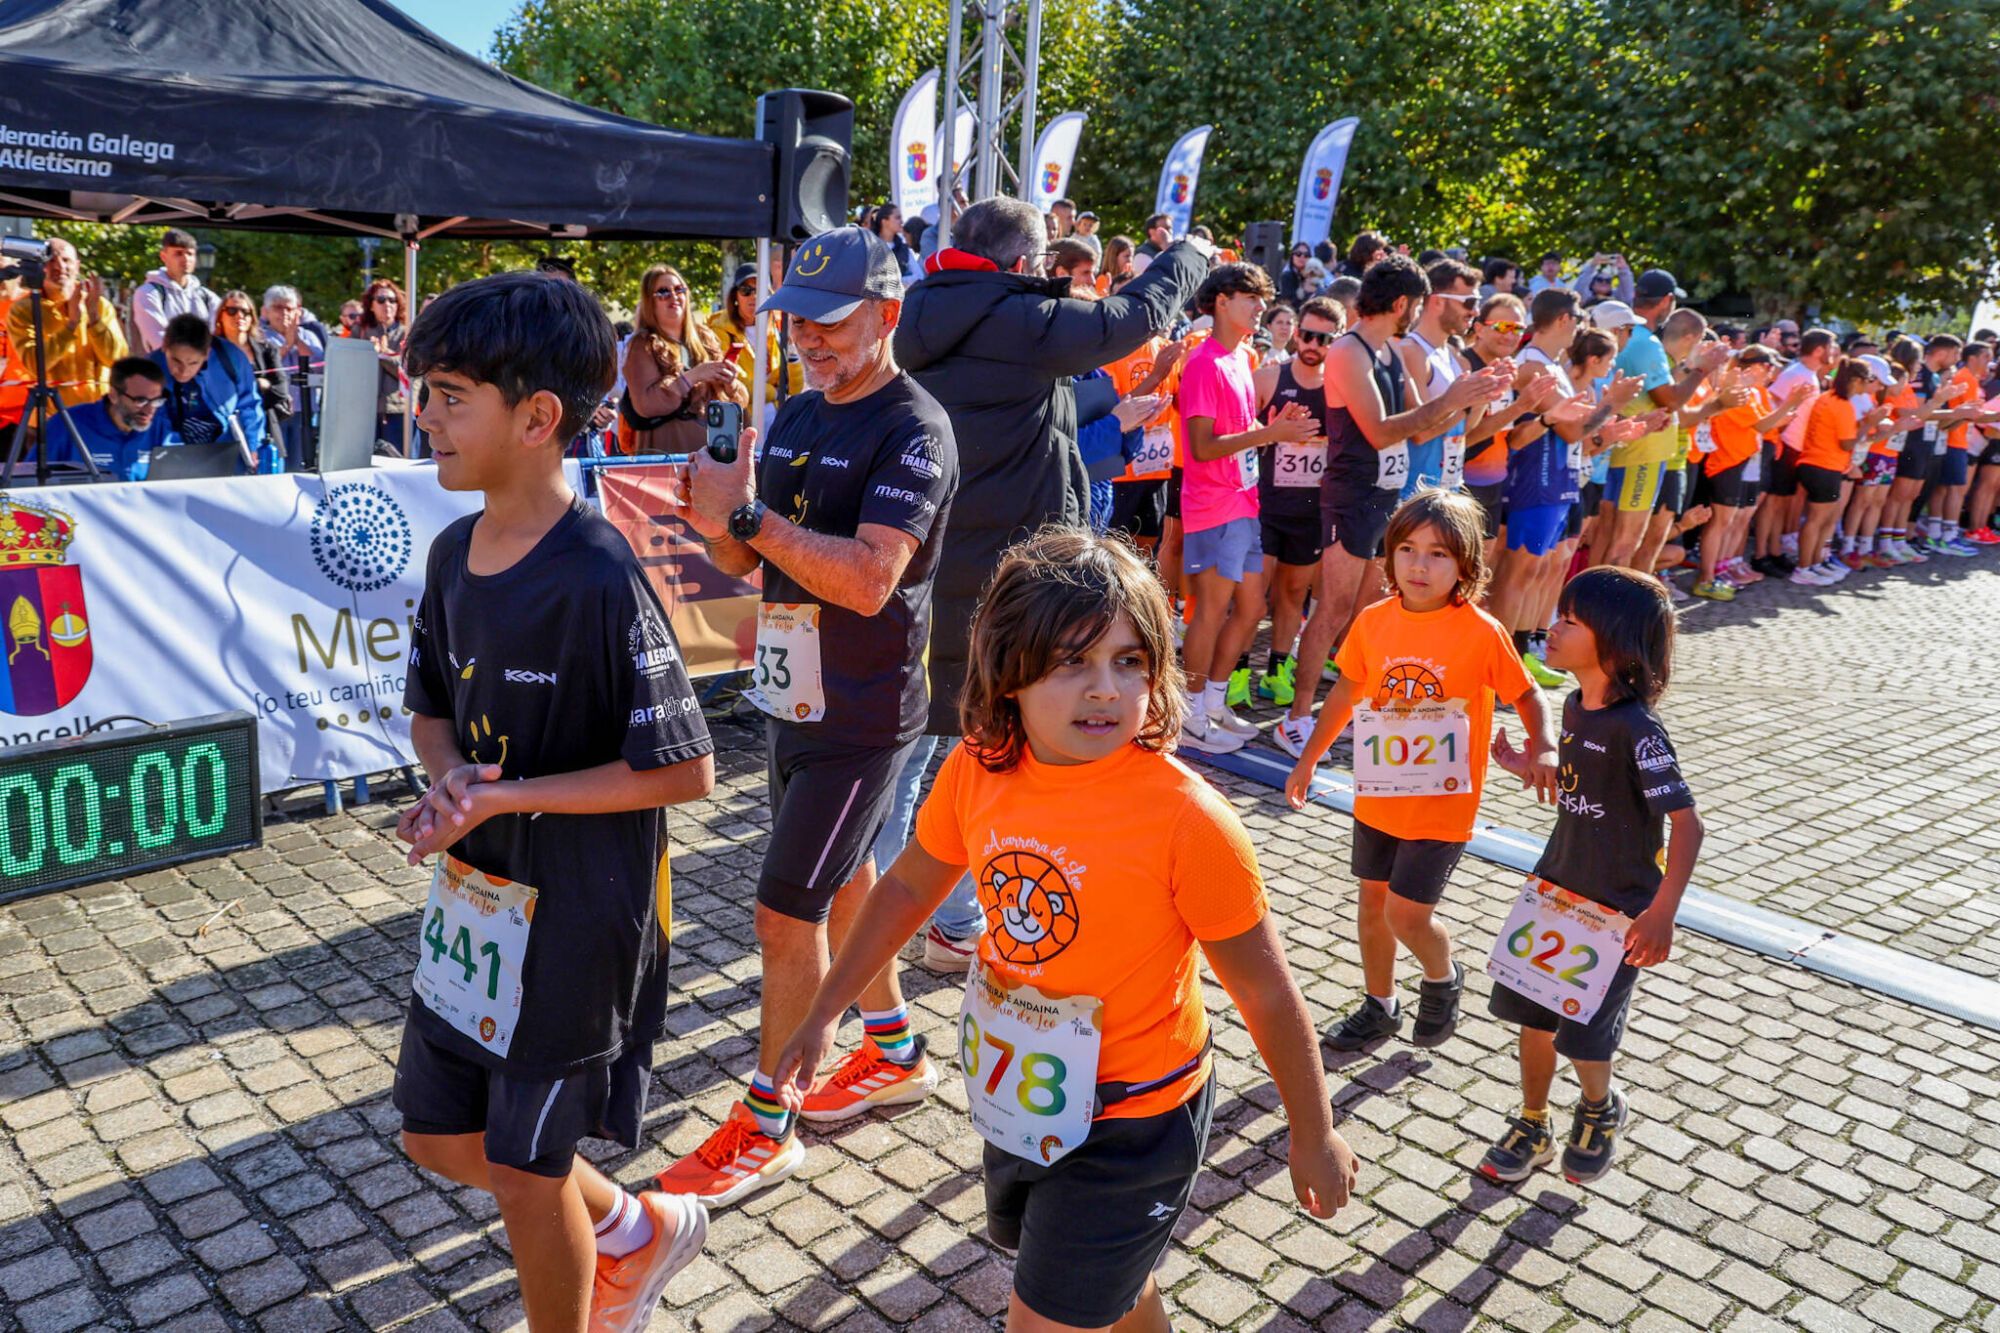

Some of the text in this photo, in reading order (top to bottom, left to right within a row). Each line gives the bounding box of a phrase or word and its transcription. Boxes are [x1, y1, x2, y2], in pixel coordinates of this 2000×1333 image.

[0, 149, 112, 178] Atletismo
[87, 132, 175, 164] Galega
[1281, 454, 1322, 475] 316
[874, 484, 937, 517] marathon
[284, 688, 322, 710] teu
[329, 673, 407, 702] camiño
[1363, 732, 1455, 766] 1021
[466, 882, 500, 902] ANDAINA
[424, 905, 501, 1001] 441
[1507, 920, 1599, 990] 622
[1012, 998, 1060, 1016] ANDAINA
[961, 1012, 1067, 1117] 878
